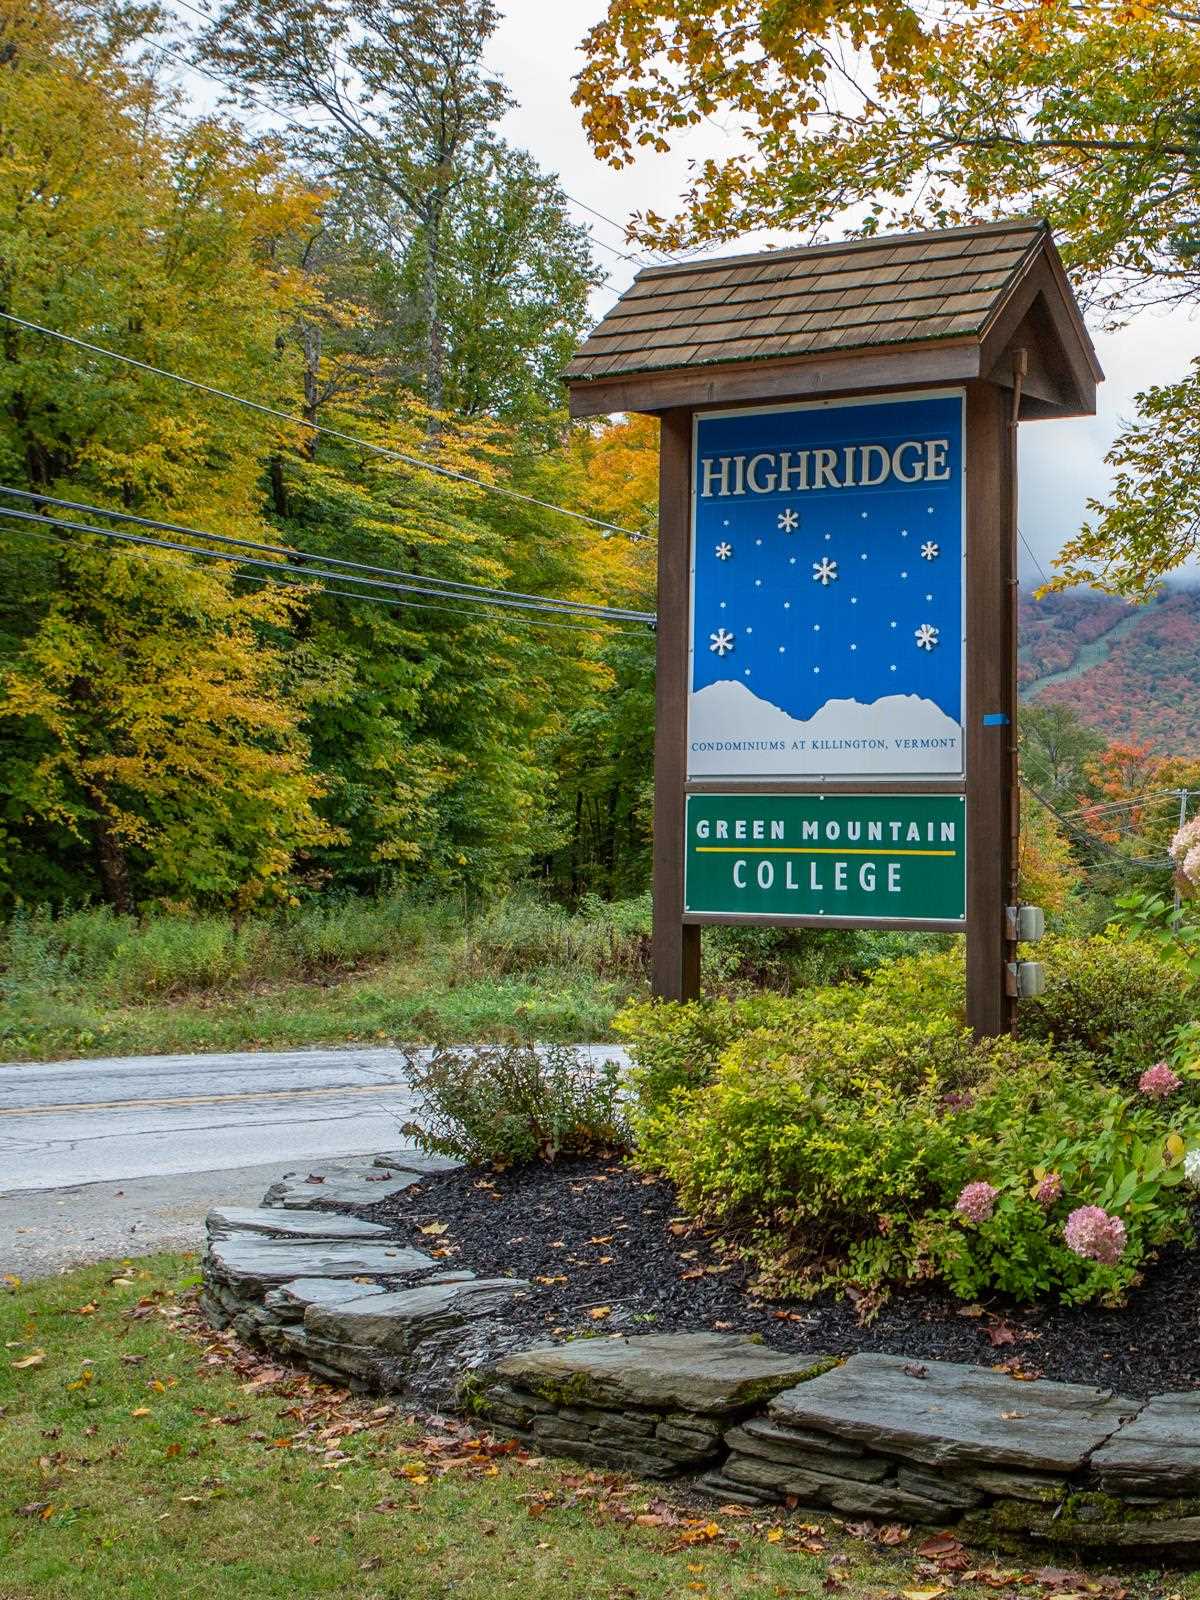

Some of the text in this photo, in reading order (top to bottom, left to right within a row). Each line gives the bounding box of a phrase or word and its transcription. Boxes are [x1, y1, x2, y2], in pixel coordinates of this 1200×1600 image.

[701, 439, 950, 497] HIGHRIDGE
[691, 738, 956, 751] CONDOMINIUMS AT KILLINGTON, VERMONT
[696, 820, 955, 842] GREEN MOUNTAIN
[732, 860, 901, 892] COLLEGE
